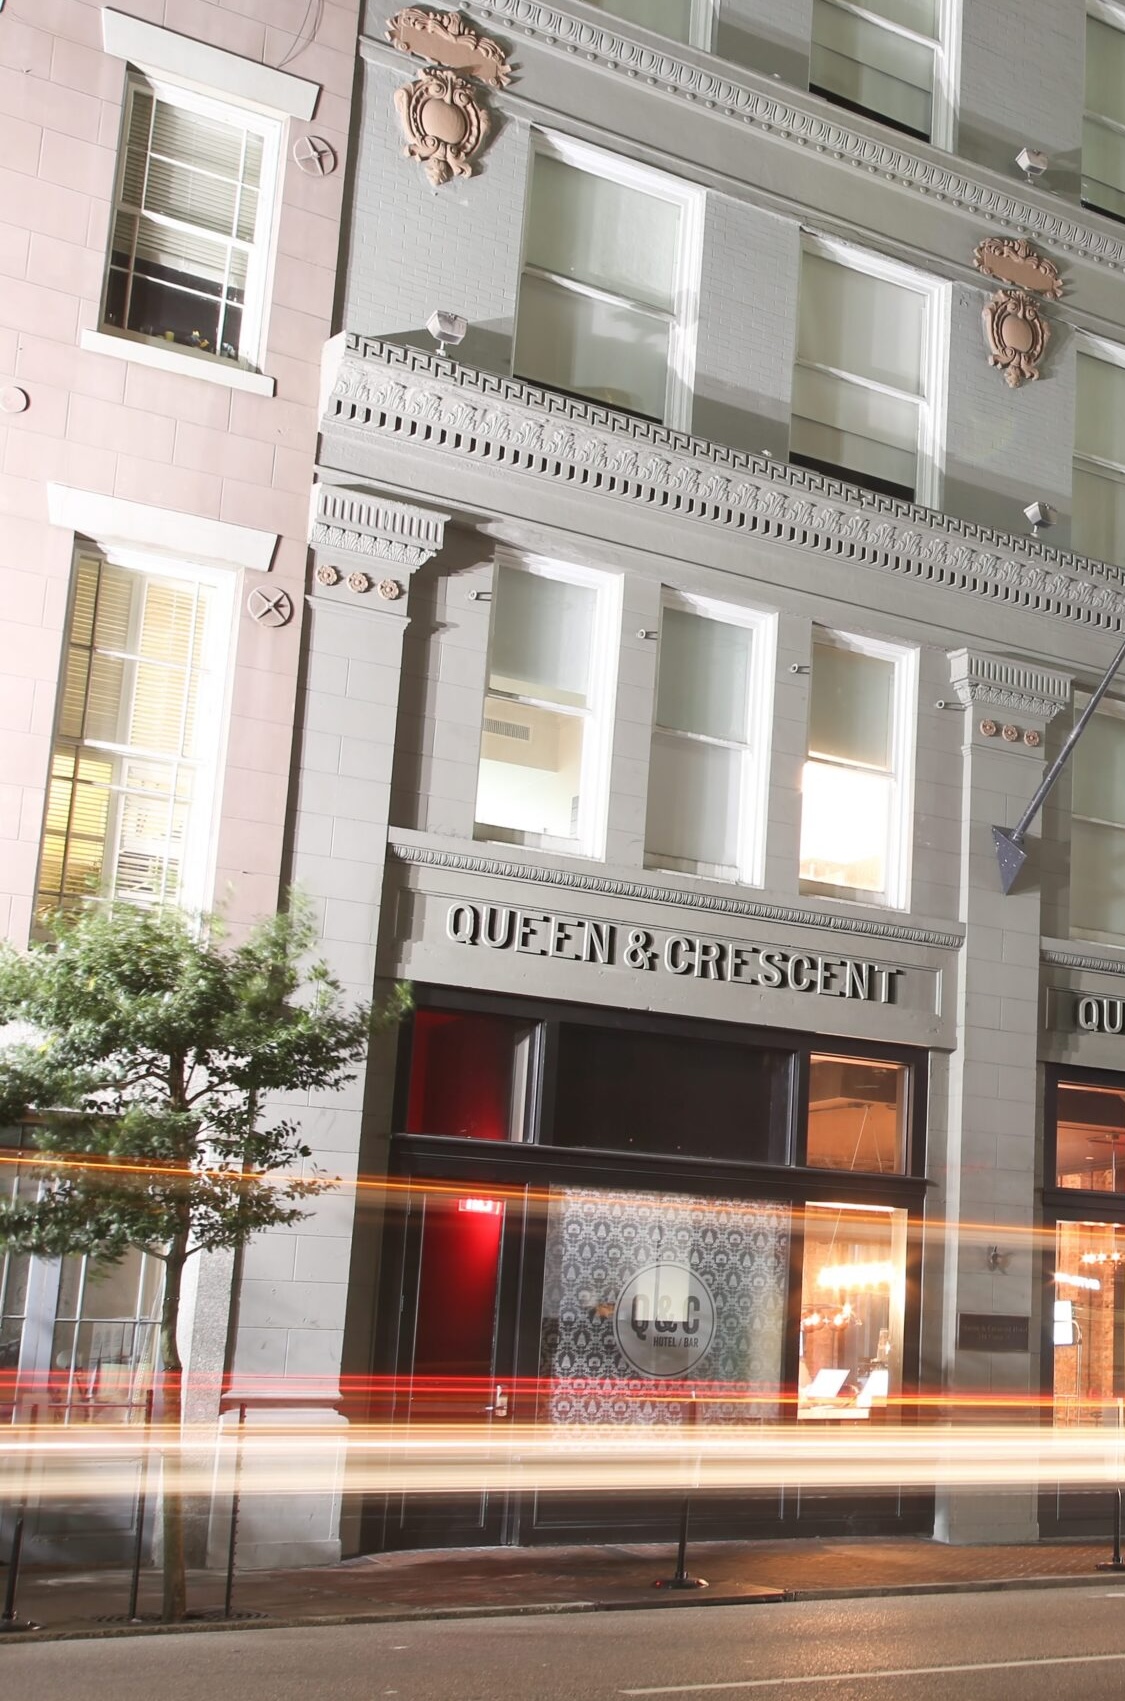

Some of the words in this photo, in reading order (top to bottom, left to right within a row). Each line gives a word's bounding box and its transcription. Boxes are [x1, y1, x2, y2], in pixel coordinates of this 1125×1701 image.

[446, 902, 615, 964] QUEEN
[623, 928, 656, 970] &
[664, 935, 903, 1003] CRESCENT
[653, 1336, 677, 1348] HOTEL
[683, 1337, 699, 1348] BAR
